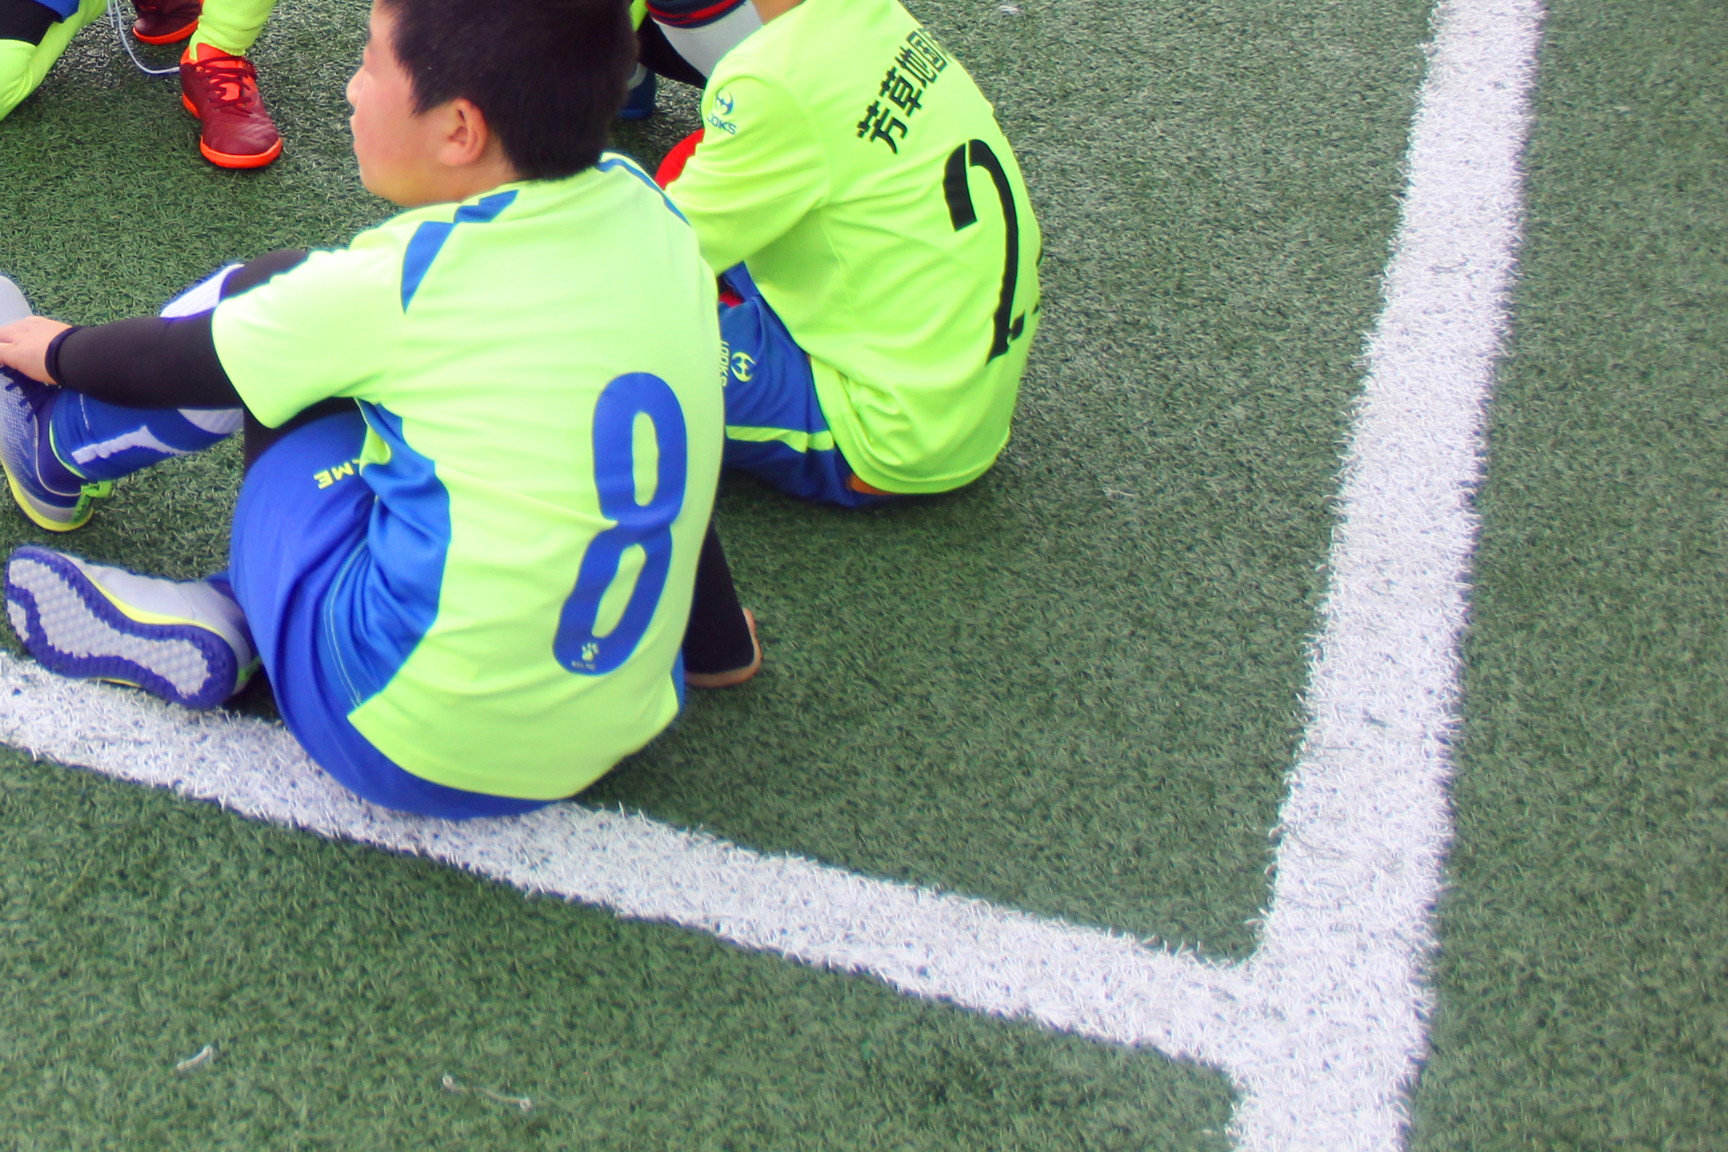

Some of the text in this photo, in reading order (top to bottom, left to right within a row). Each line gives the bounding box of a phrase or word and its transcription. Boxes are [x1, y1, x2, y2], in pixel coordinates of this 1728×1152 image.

[855, 28, 952, 156] 芳草地国
[552, 372, 687, 676] 8
